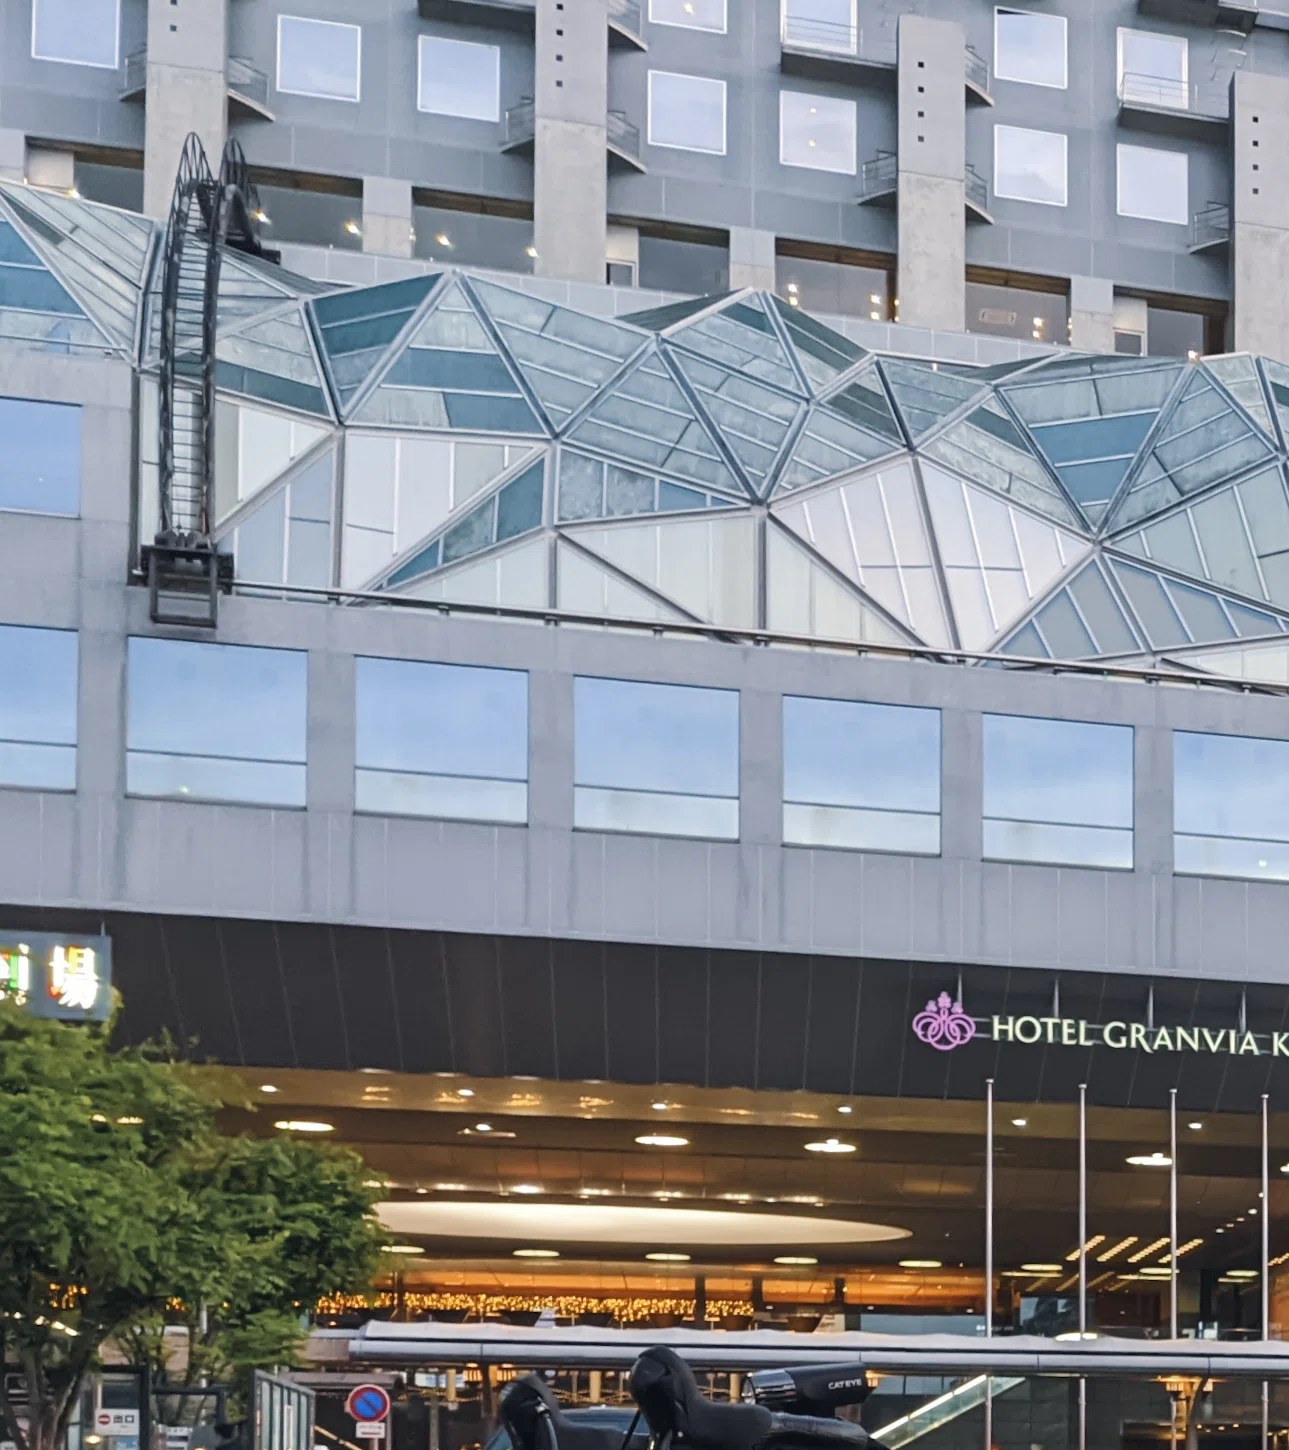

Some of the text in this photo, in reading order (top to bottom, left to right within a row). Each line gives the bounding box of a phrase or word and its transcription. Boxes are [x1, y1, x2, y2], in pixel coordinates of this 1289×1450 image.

[991, 1014, 1095, 1047] HOTEL
[1103, 1020, 1261, 1055] GRANVIA
[828, 1378, 862, 1390] CATEYE
